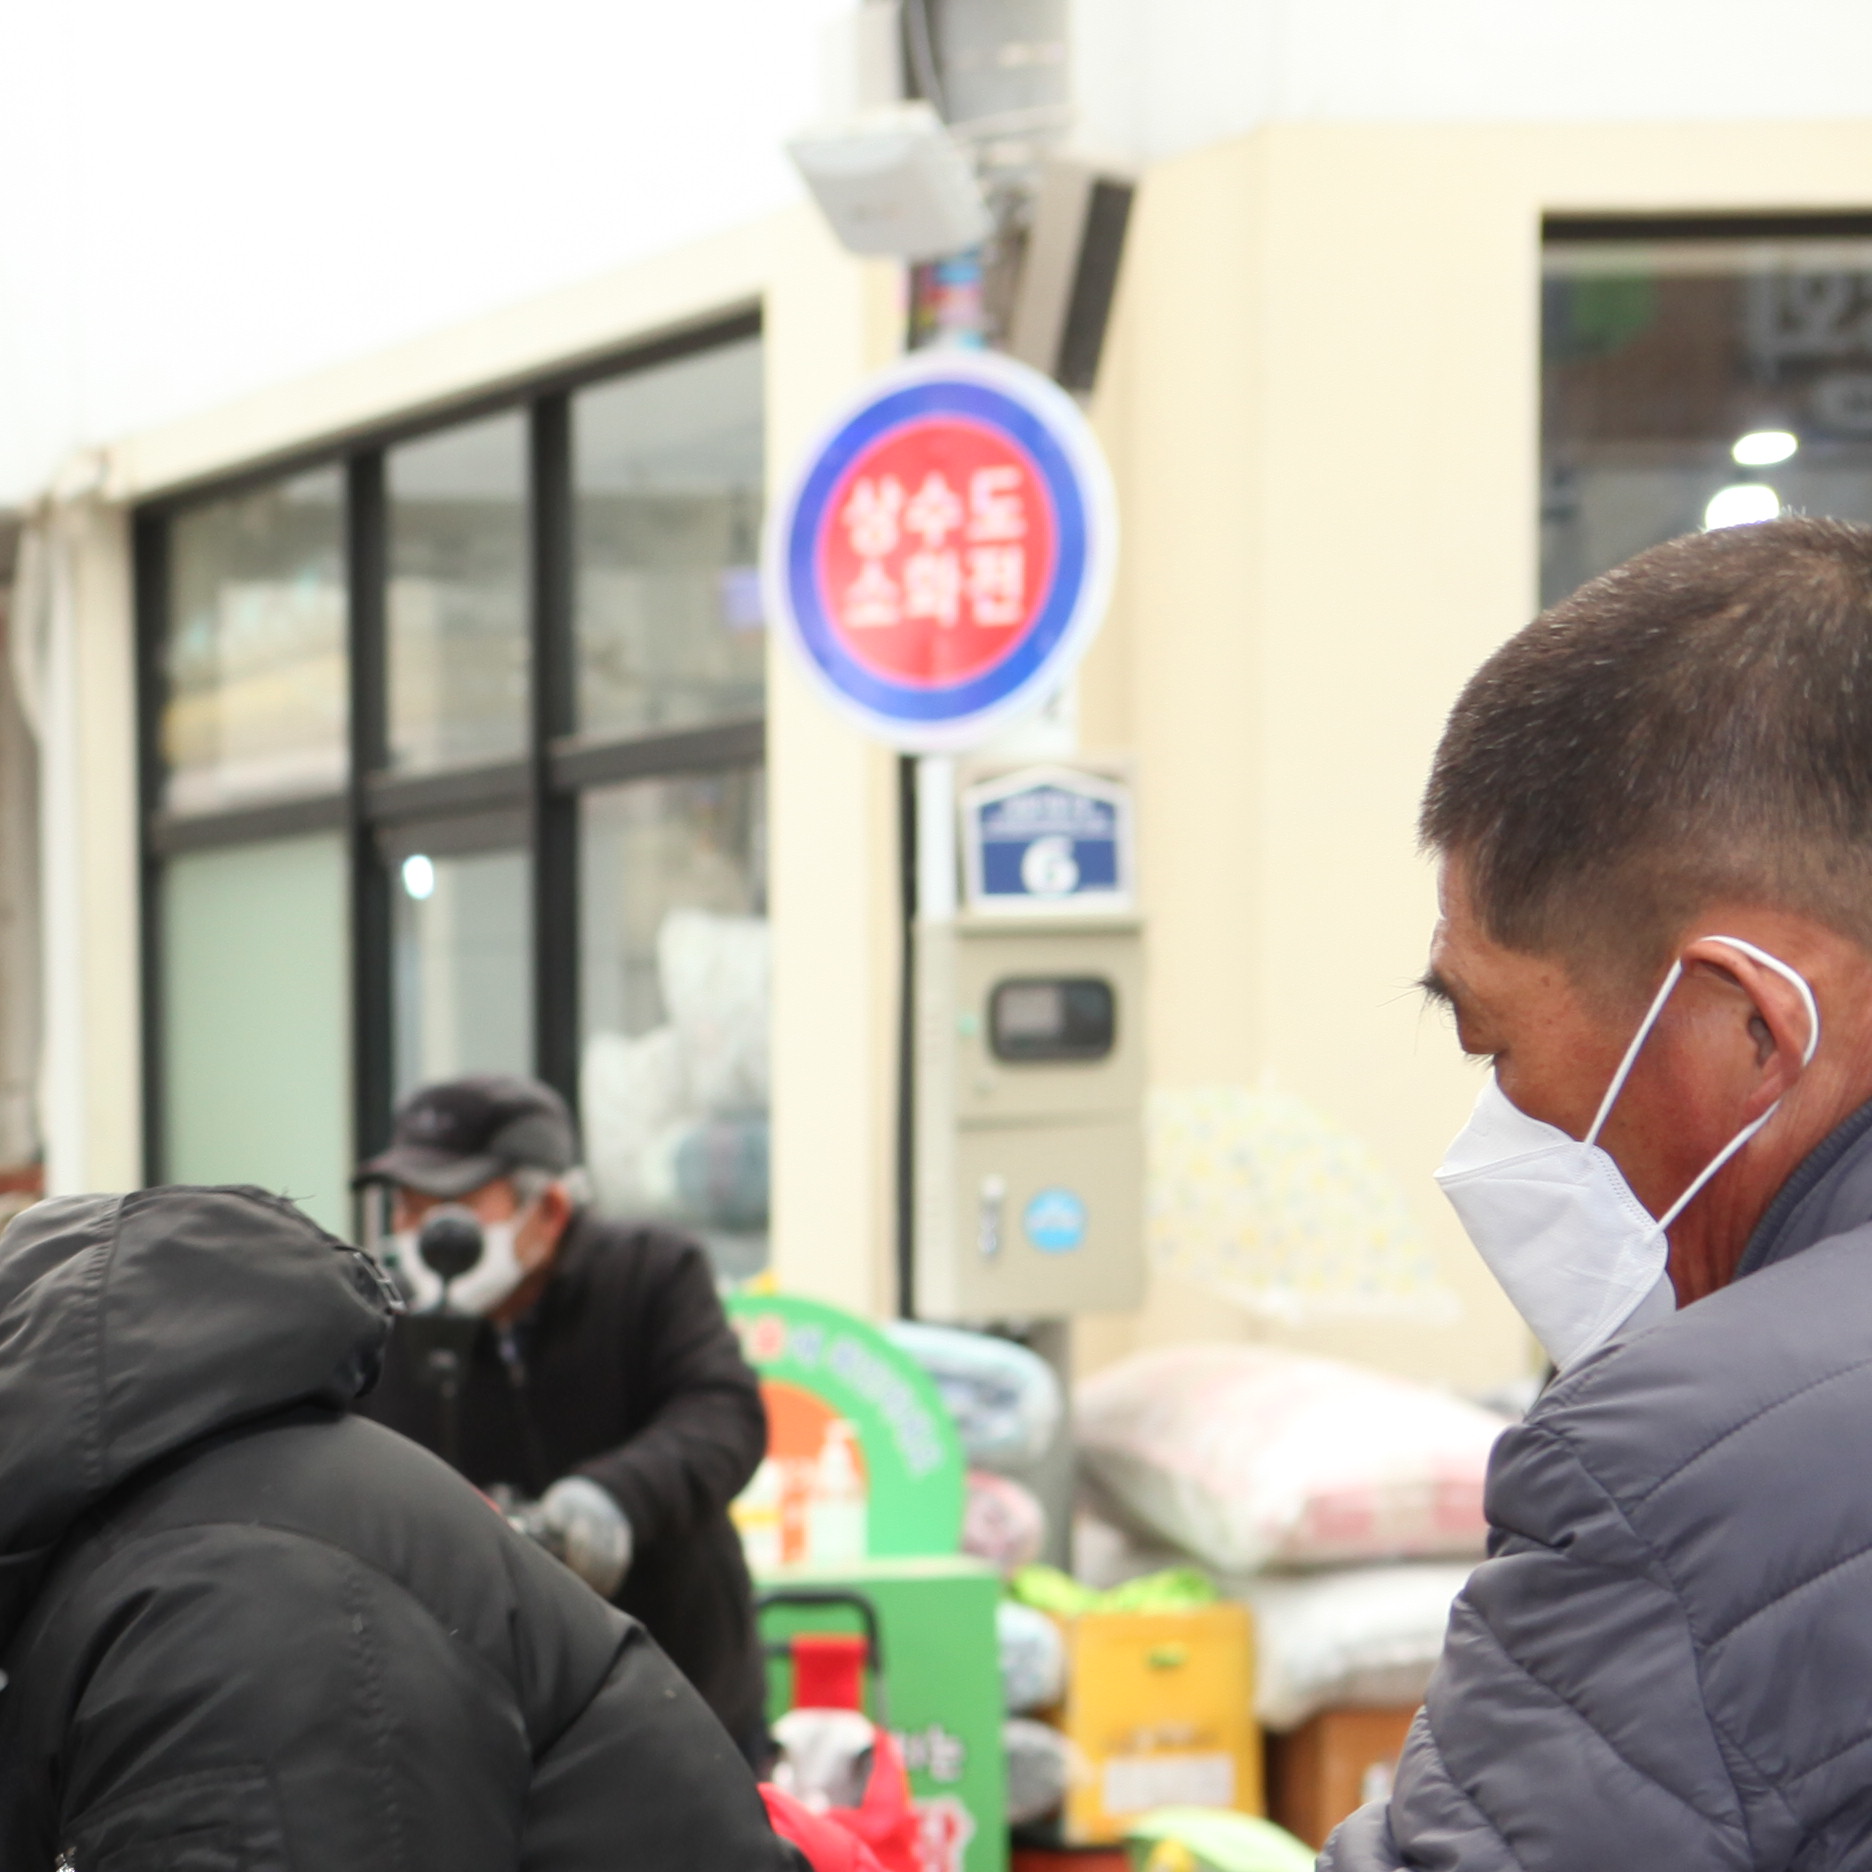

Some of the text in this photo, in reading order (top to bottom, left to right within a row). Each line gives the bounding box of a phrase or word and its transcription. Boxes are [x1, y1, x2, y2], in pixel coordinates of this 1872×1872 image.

[841, 464, 1028, 556] 상수도
[842, 546, 1026, 628] 소화전
[1021, 834, 1080, 898] 6
